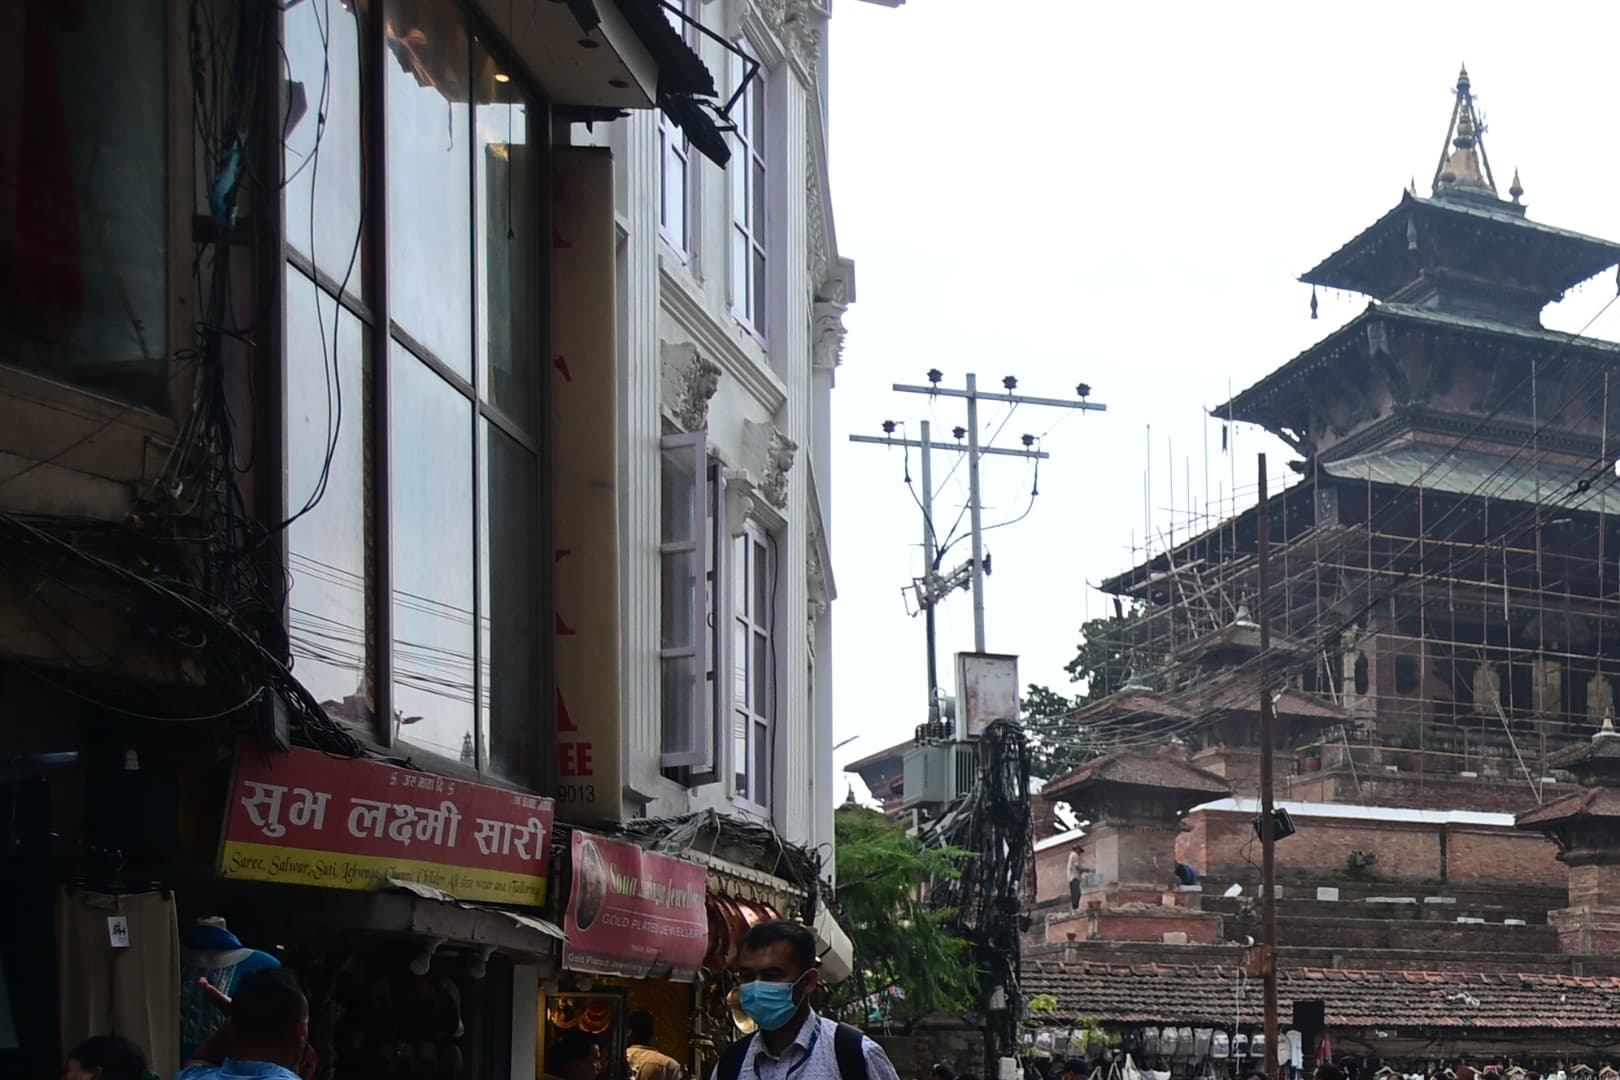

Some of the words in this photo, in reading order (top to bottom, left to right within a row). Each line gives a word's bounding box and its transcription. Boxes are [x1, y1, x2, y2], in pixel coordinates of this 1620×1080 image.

[241, 780, 332, 838] सुभ
[347, 798, 462, 847] लक्ष्मी
[474, 817, 546, 861] सारी
[602, 913, 630, 928] GOLD
